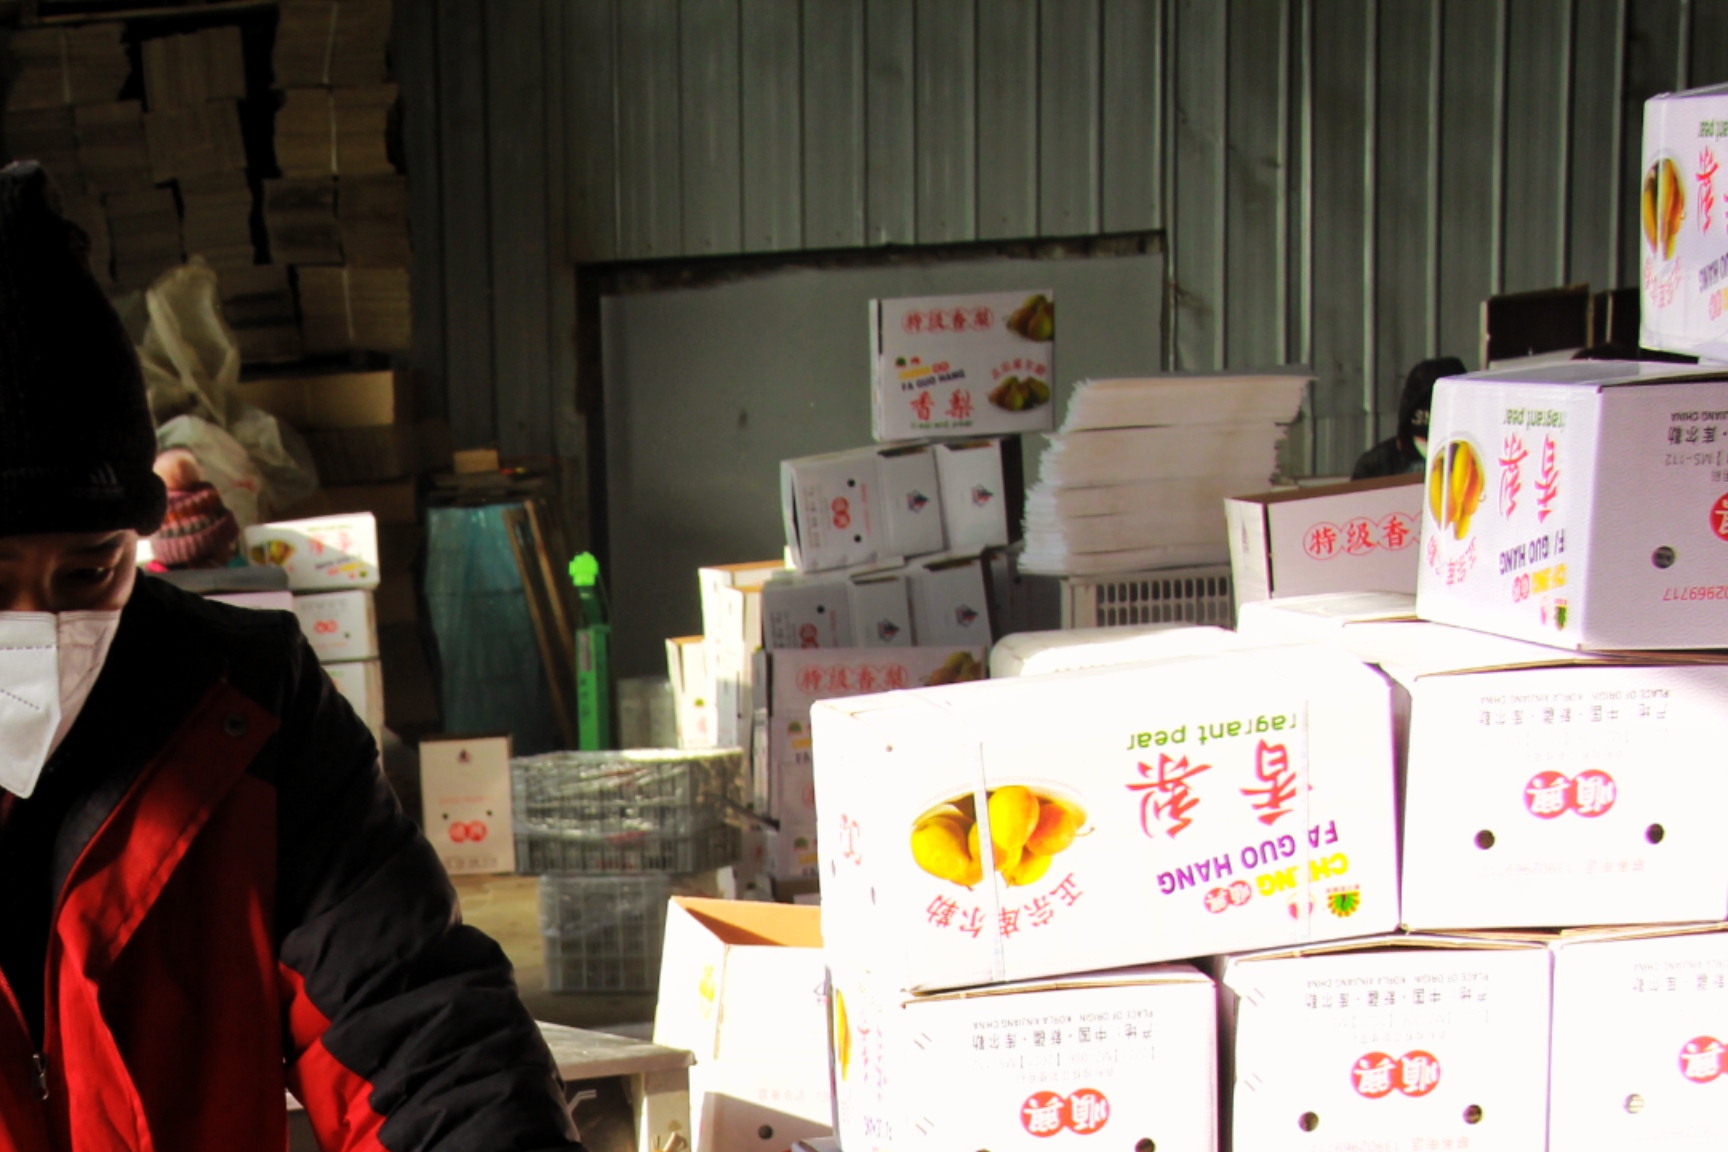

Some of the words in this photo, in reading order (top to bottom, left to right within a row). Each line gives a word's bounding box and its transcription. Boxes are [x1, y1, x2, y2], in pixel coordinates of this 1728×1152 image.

[1126, 724, 1185, 750] pear
[1196, 713, 1295, 747] ragrant
[1124, 737, 1312, 838] 香梨
[1527, 774, 1612, 812] 順興
[1240, 831, 1295, 868] GUO
[1156, 853, 1230, 893] HANG
[1255, 851, 1348, 897] CHNG
[1353, 1056, 1436, 1091] 順興
[1682, 1042, 1728, 1076] 興
[1023, 1093, 1106, 1130] 順興
